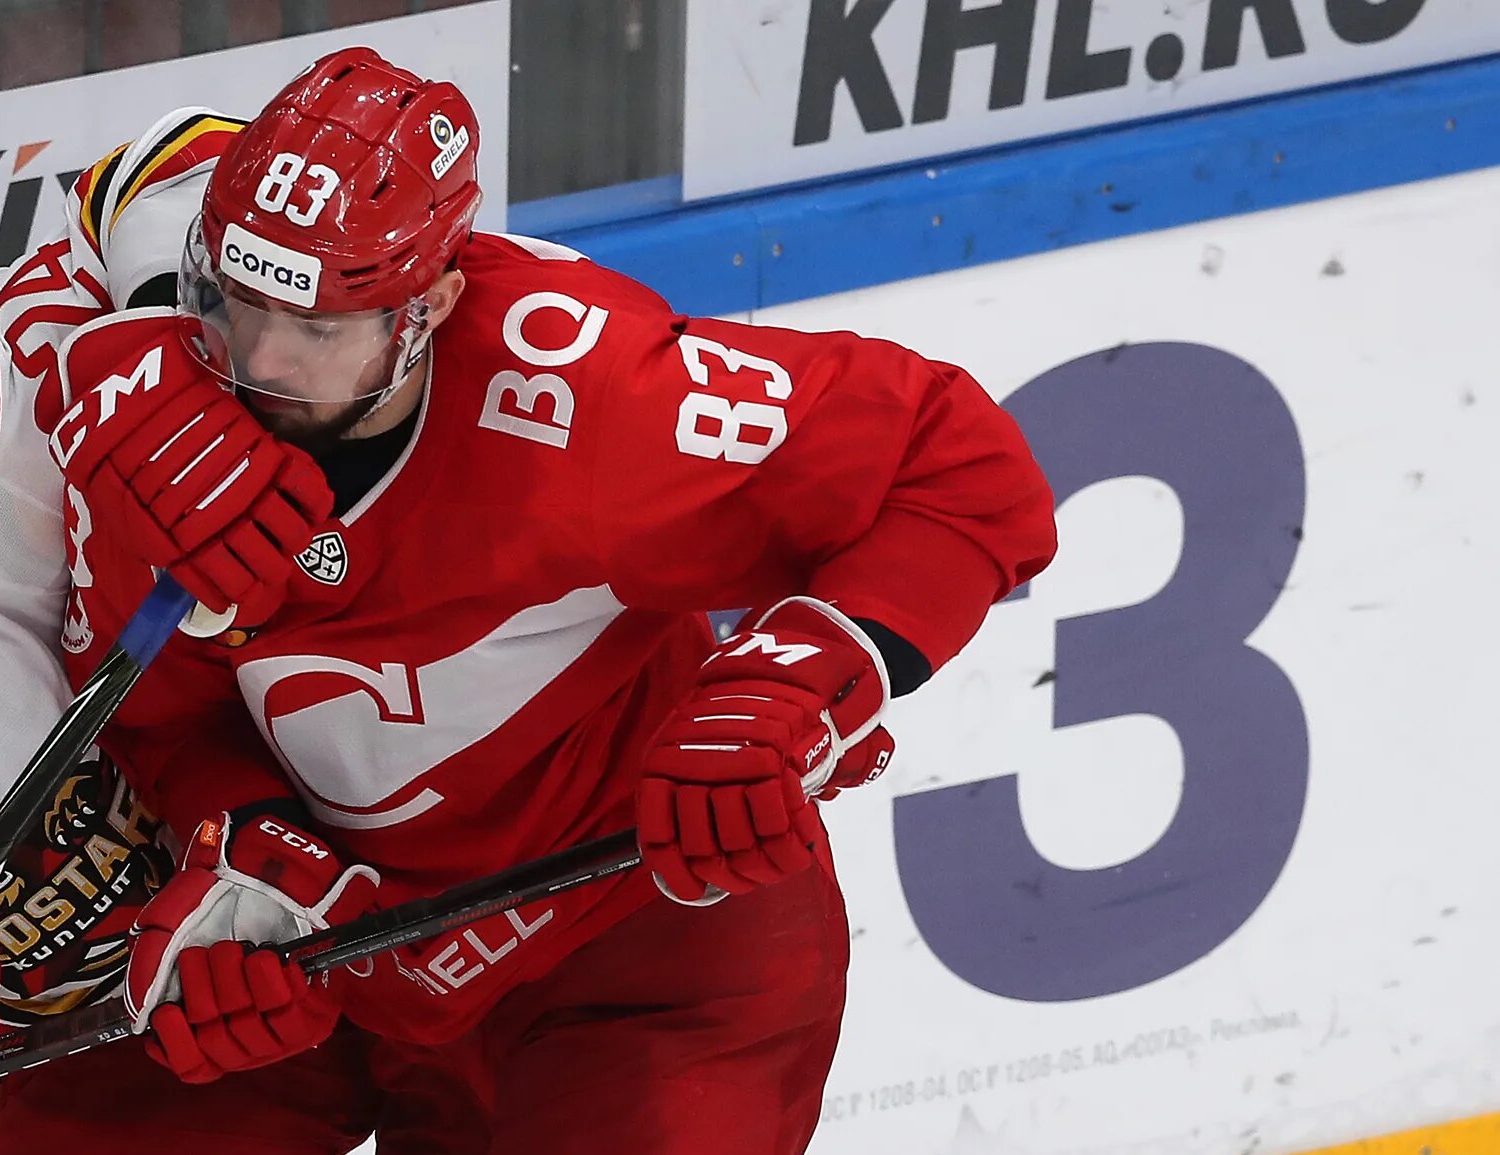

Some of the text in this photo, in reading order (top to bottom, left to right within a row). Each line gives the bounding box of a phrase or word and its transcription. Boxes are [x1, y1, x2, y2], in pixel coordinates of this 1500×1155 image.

[255, 152, 340, 227] 83
[434, 134, 467, 174] ERIELL
[48, 345, 163, 469] CM
[674, 333, 794, 465] 83
[259, 819, 329, 860] CCM
